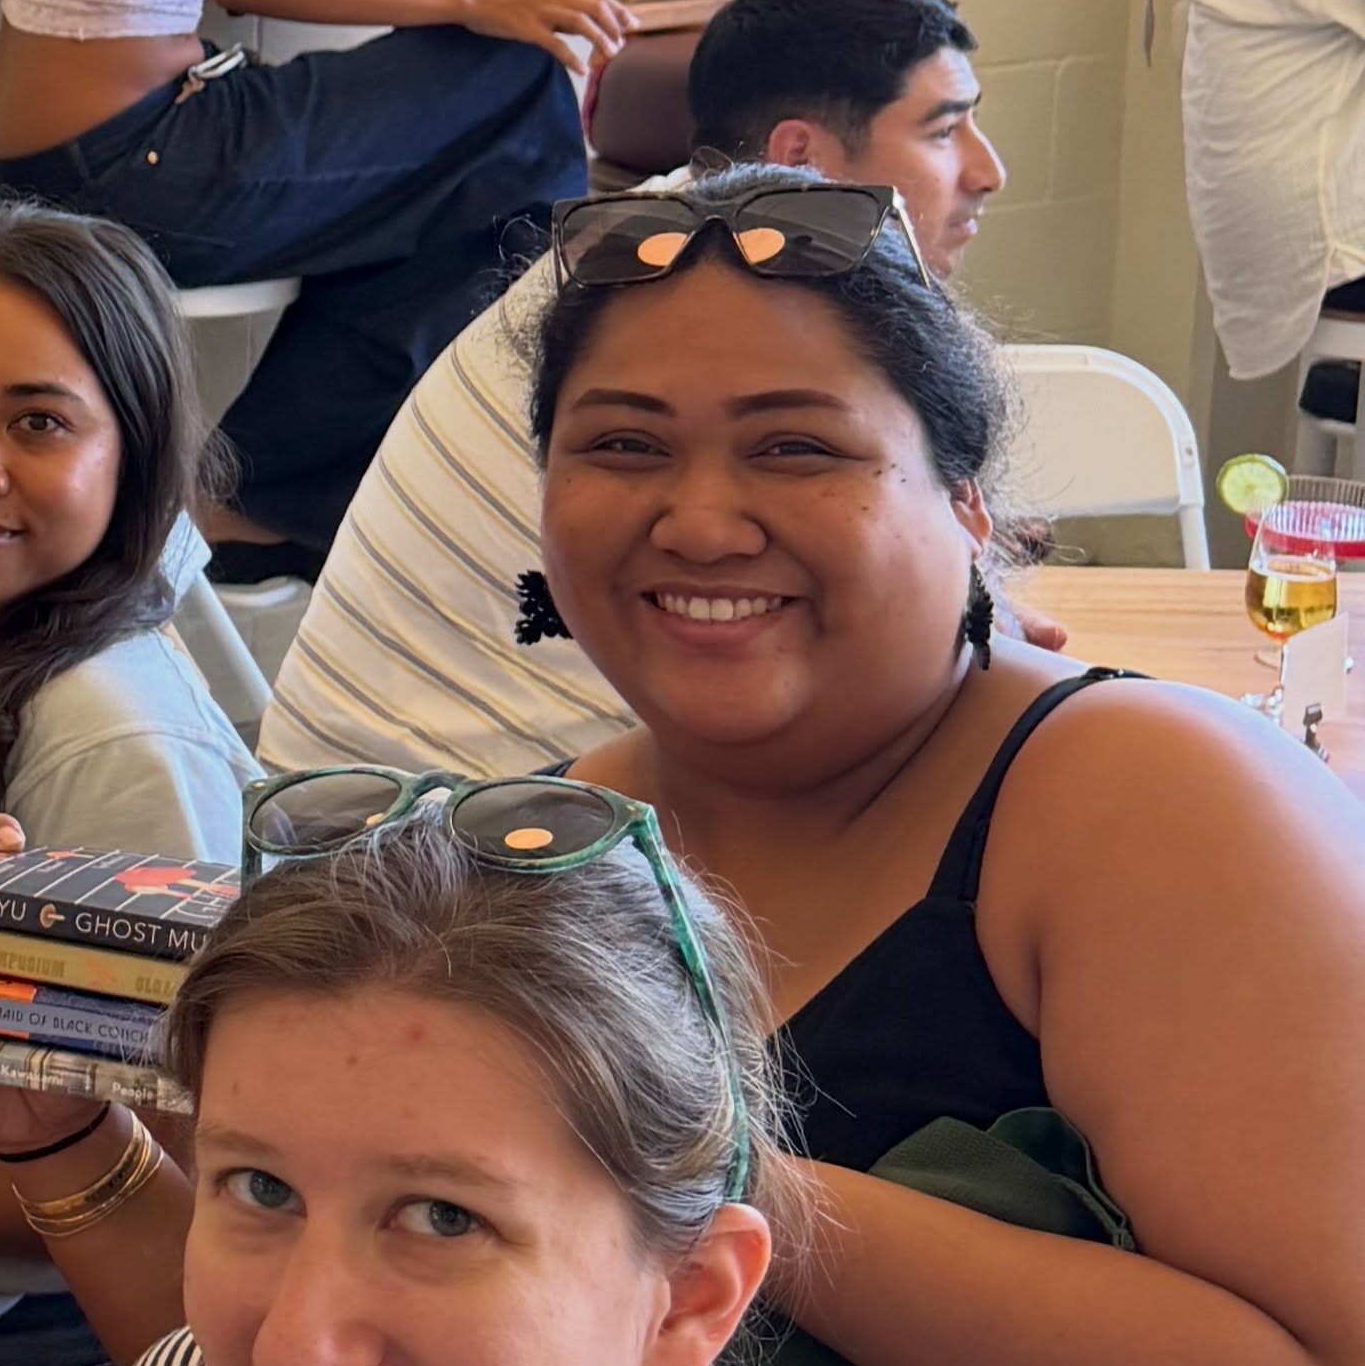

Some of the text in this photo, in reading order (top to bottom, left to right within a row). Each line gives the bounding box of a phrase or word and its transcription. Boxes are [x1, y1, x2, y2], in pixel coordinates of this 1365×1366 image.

[75, 912, 162, 946] GHOST
[29, 1011, 47, 1027] OF
[52, 1016, 93, 1035] BLACK
[112, 1081, 154, 1101] People
